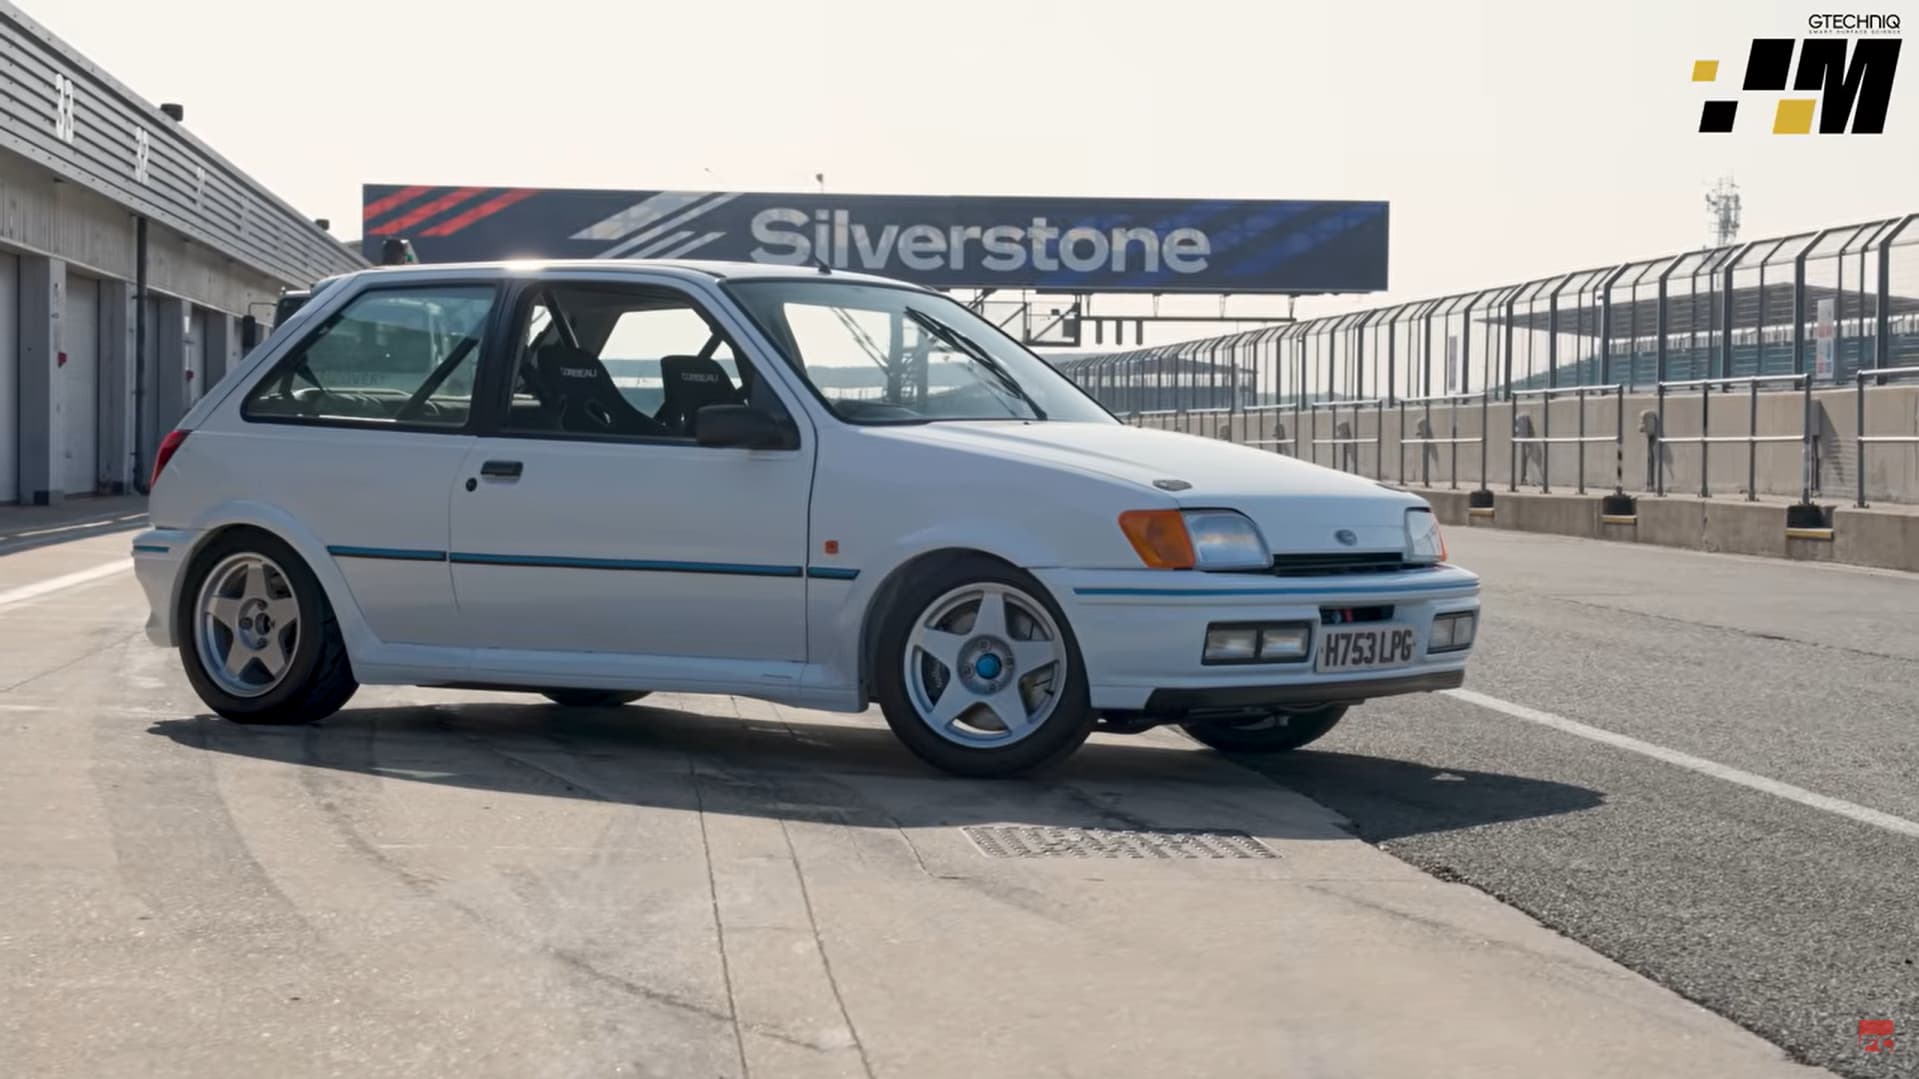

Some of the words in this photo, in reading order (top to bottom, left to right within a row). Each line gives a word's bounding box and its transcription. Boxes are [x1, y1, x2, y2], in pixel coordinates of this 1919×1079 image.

[749, 207, 1211, 274] Silverstone
[1325, 631, 1377, 667] H753
[1380, 629, 1413, 664] LPG
